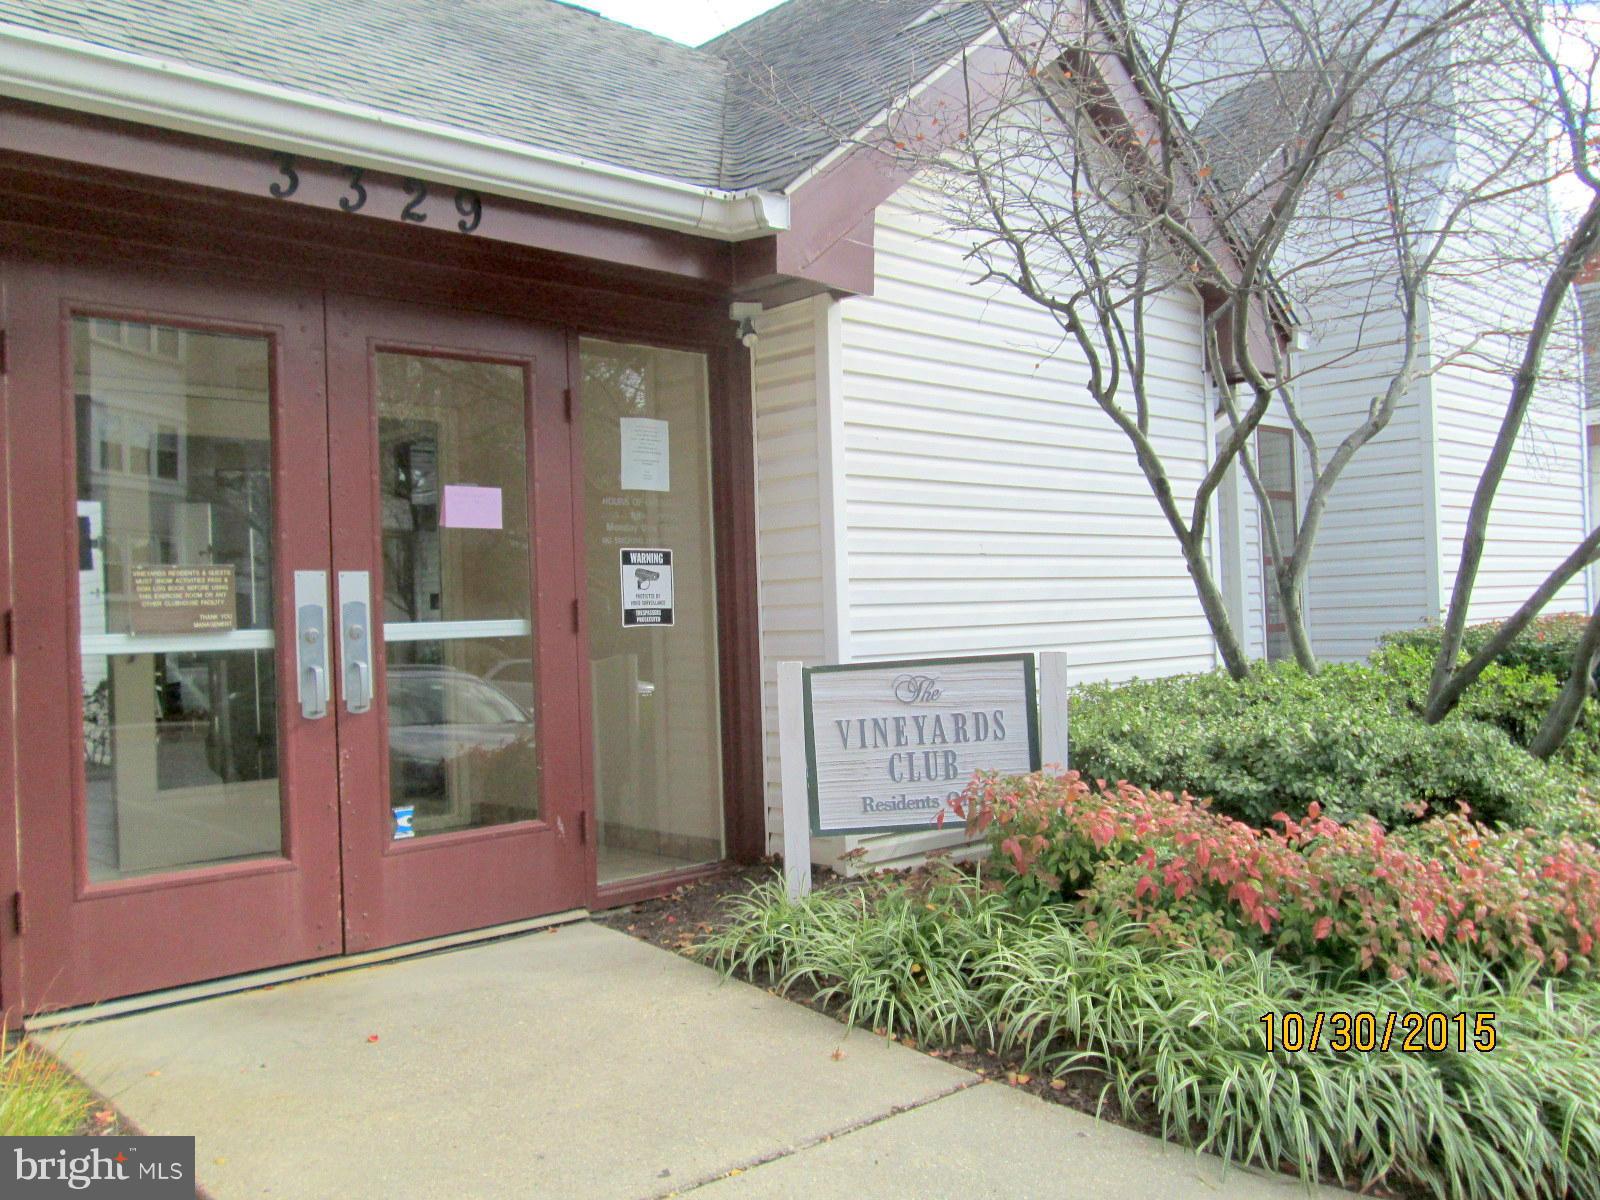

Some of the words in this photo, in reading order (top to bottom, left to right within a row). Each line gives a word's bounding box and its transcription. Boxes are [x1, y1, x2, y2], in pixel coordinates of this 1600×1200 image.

[269, 152, 482, 234] 3329
[630, 552, 664, 564] WARNING
[892, 674, 945, 704] The
[835, 709, 1006, 750] VINEYARDS
[888, 750, 959, 783] CLUB
[861, 794, 940, 813] Residents
